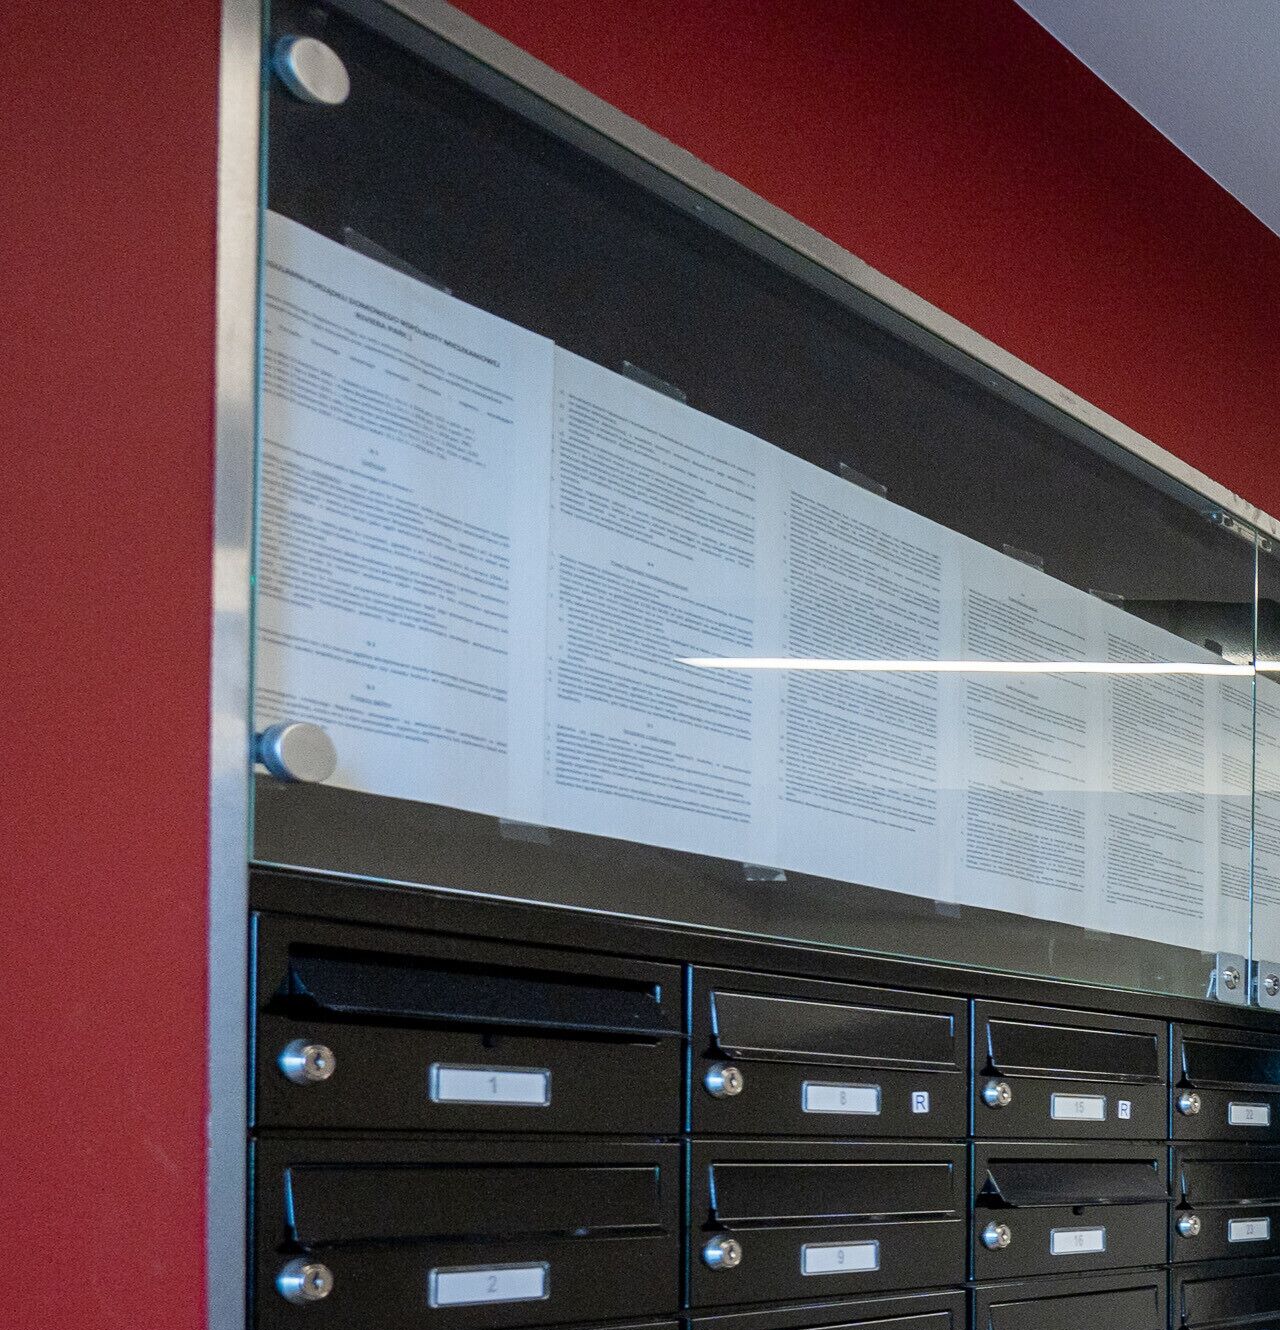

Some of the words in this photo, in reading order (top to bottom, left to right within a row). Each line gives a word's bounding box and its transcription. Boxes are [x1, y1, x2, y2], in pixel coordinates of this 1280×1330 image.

[488, 1076, 498, 1094] 1
[915, 1094, 926, 1111] R
[1073, 1101, 1085, 1114] 15
[1120, 1103, 1129, 1117] R
[837, 1250, 846, 1264] 9
[486, 1275, 498, 1293] 2
